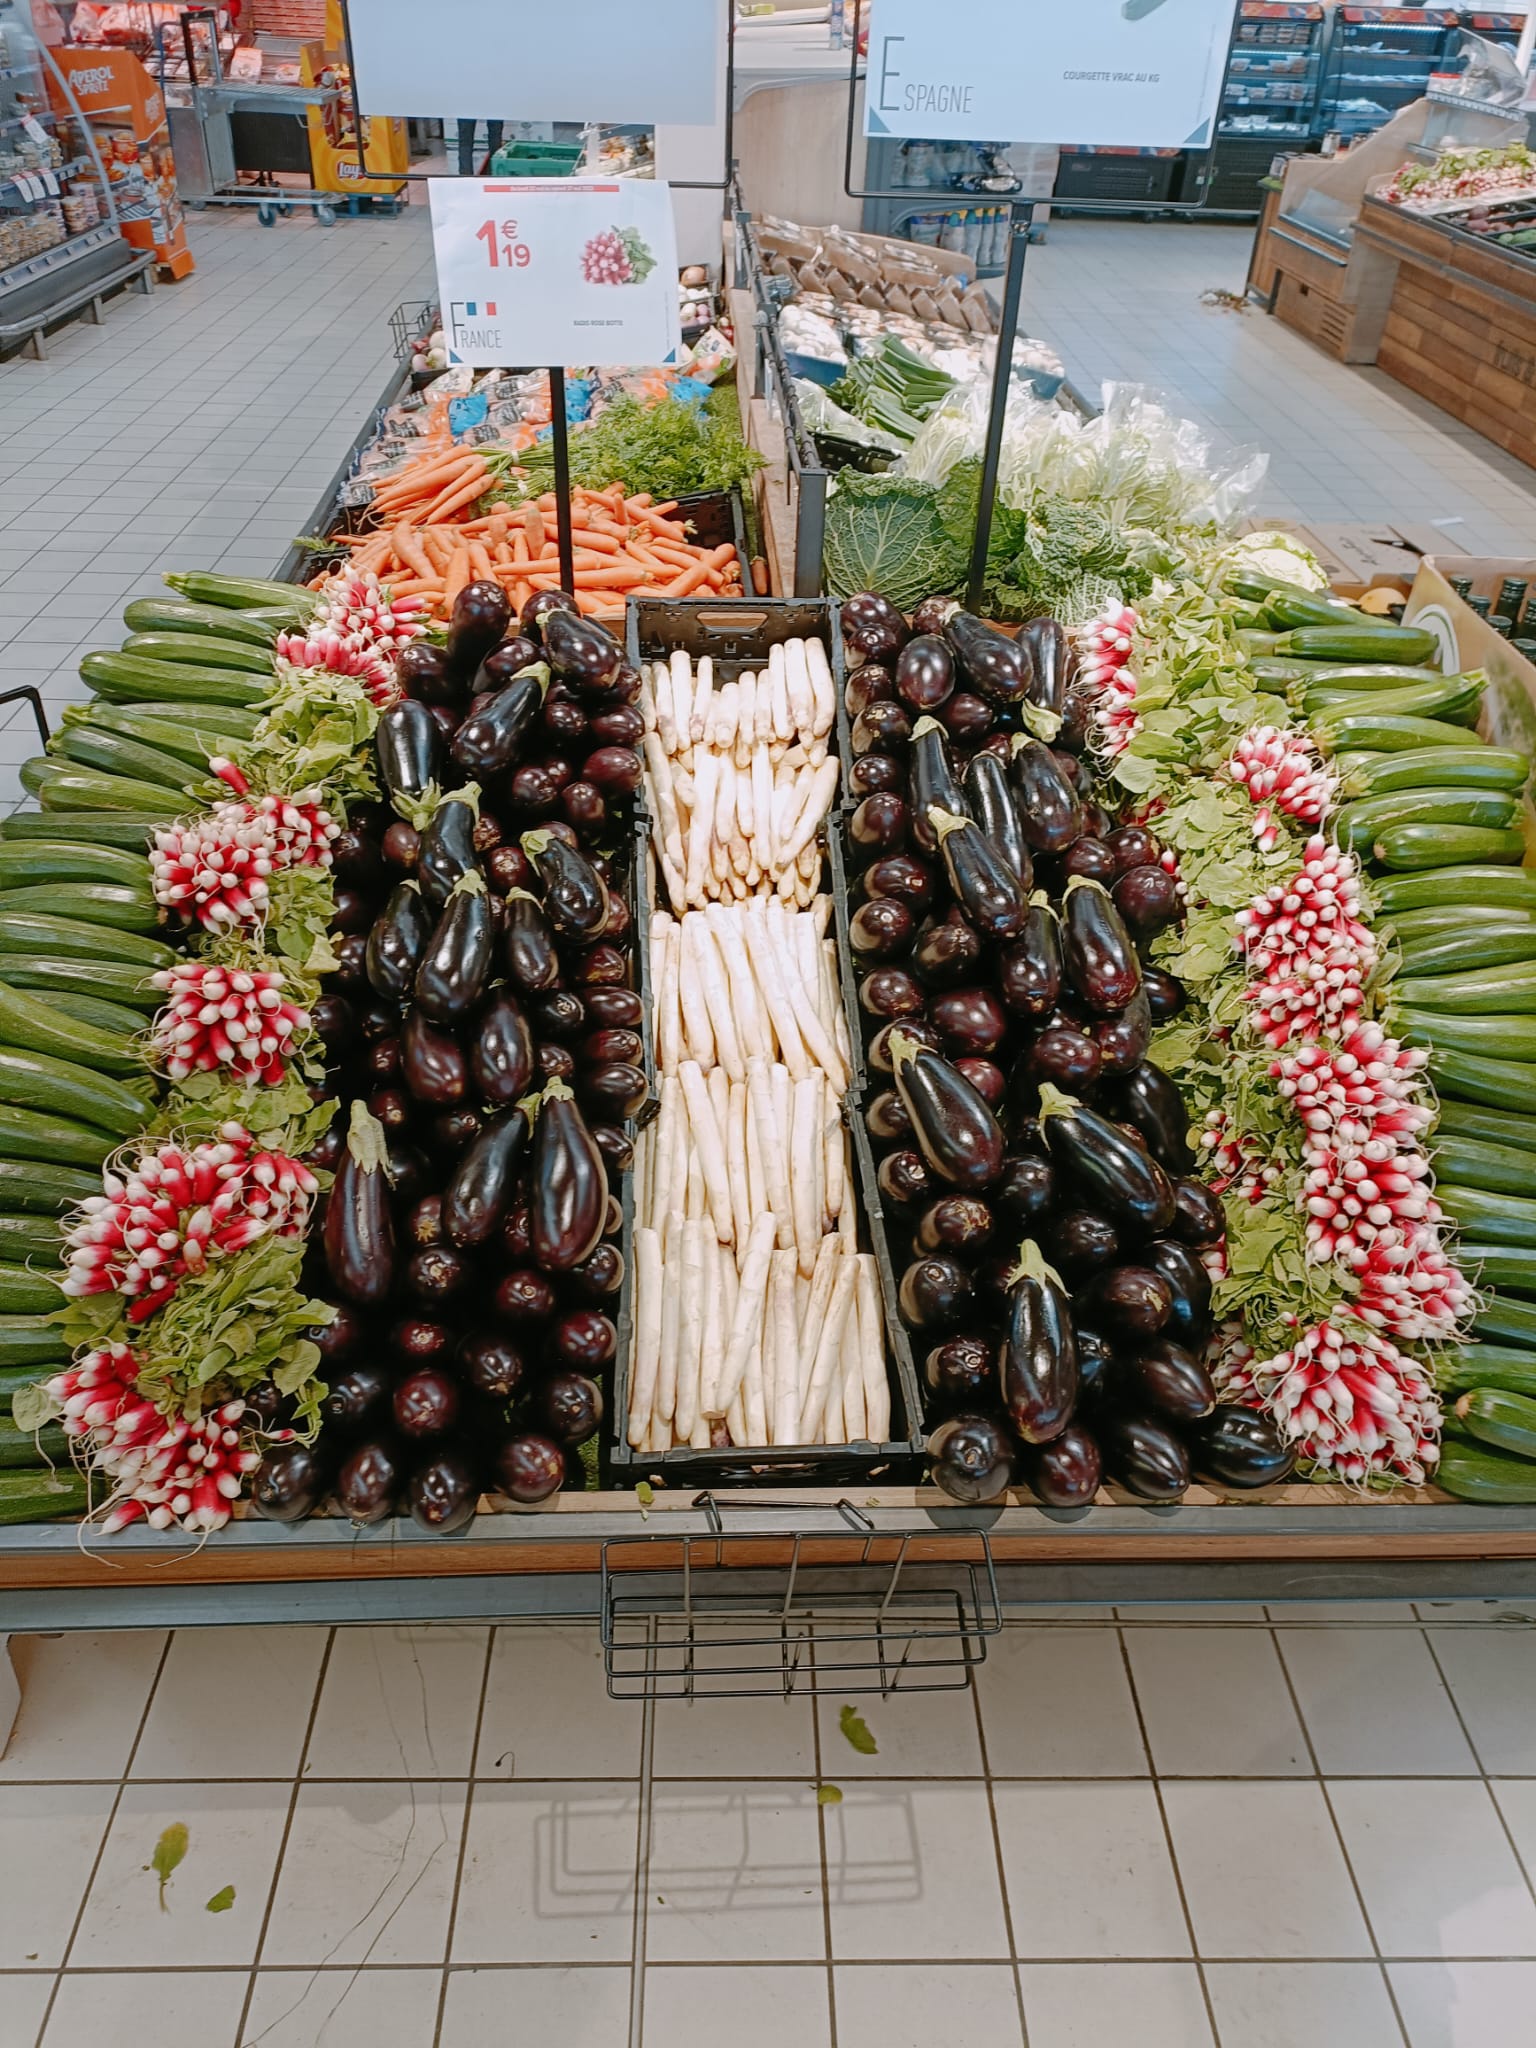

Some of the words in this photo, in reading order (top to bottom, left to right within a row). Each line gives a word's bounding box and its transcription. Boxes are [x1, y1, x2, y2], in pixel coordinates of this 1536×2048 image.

[68, 65, 116, 89] APEROL
[880, 36, 975, 113] ESPAGNE
[1063, 71, 1111, 81] COURGETTE
[1112, 72, 1135, 82] VRAC
[1135, 73, 1148, 82] AU
[1148, 73, 1161, 83] KG
[338, 162, 364, 180] Lay
[450, 302, 503, 348] FRANCE
